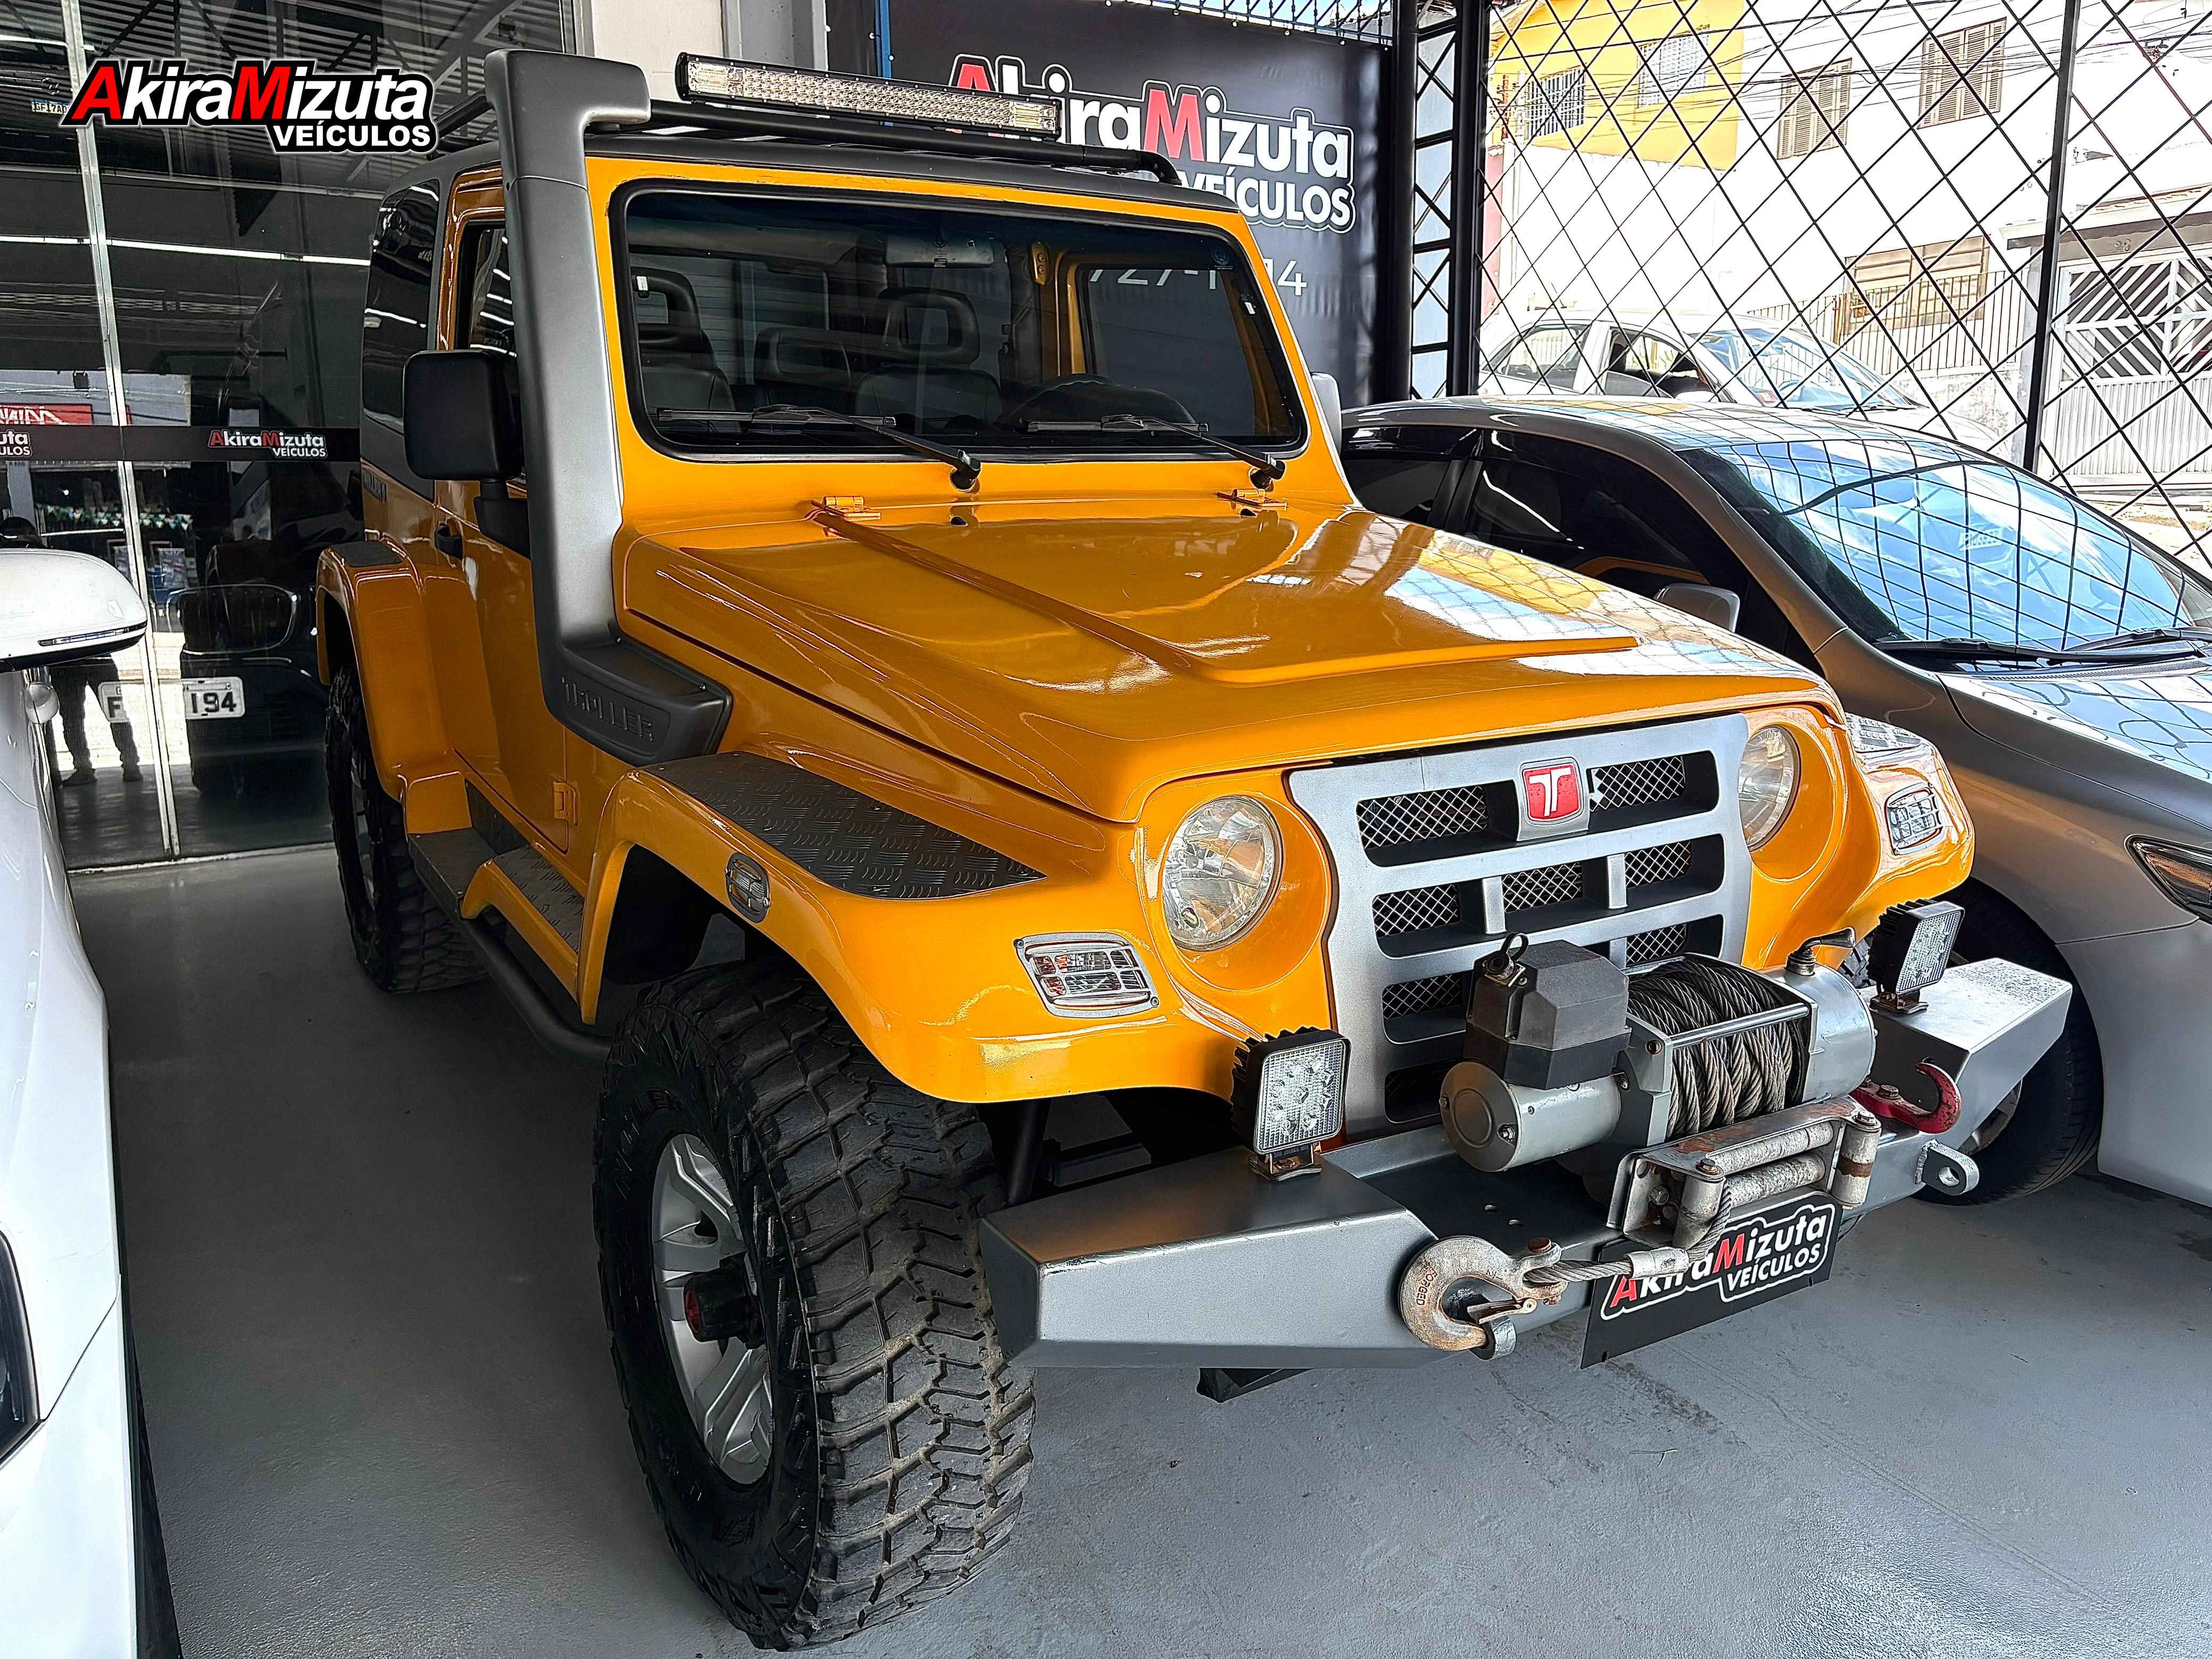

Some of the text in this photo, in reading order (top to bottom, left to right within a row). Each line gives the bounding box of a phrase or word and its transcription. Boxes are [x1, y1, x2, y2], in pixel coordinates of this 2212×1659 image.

[210, 431, 324, 447] AkiraMizuta
[273, 445, 326, 457] VEÍCULOS
[1727, 1243, 1822, 1292] VEÍCULOS
